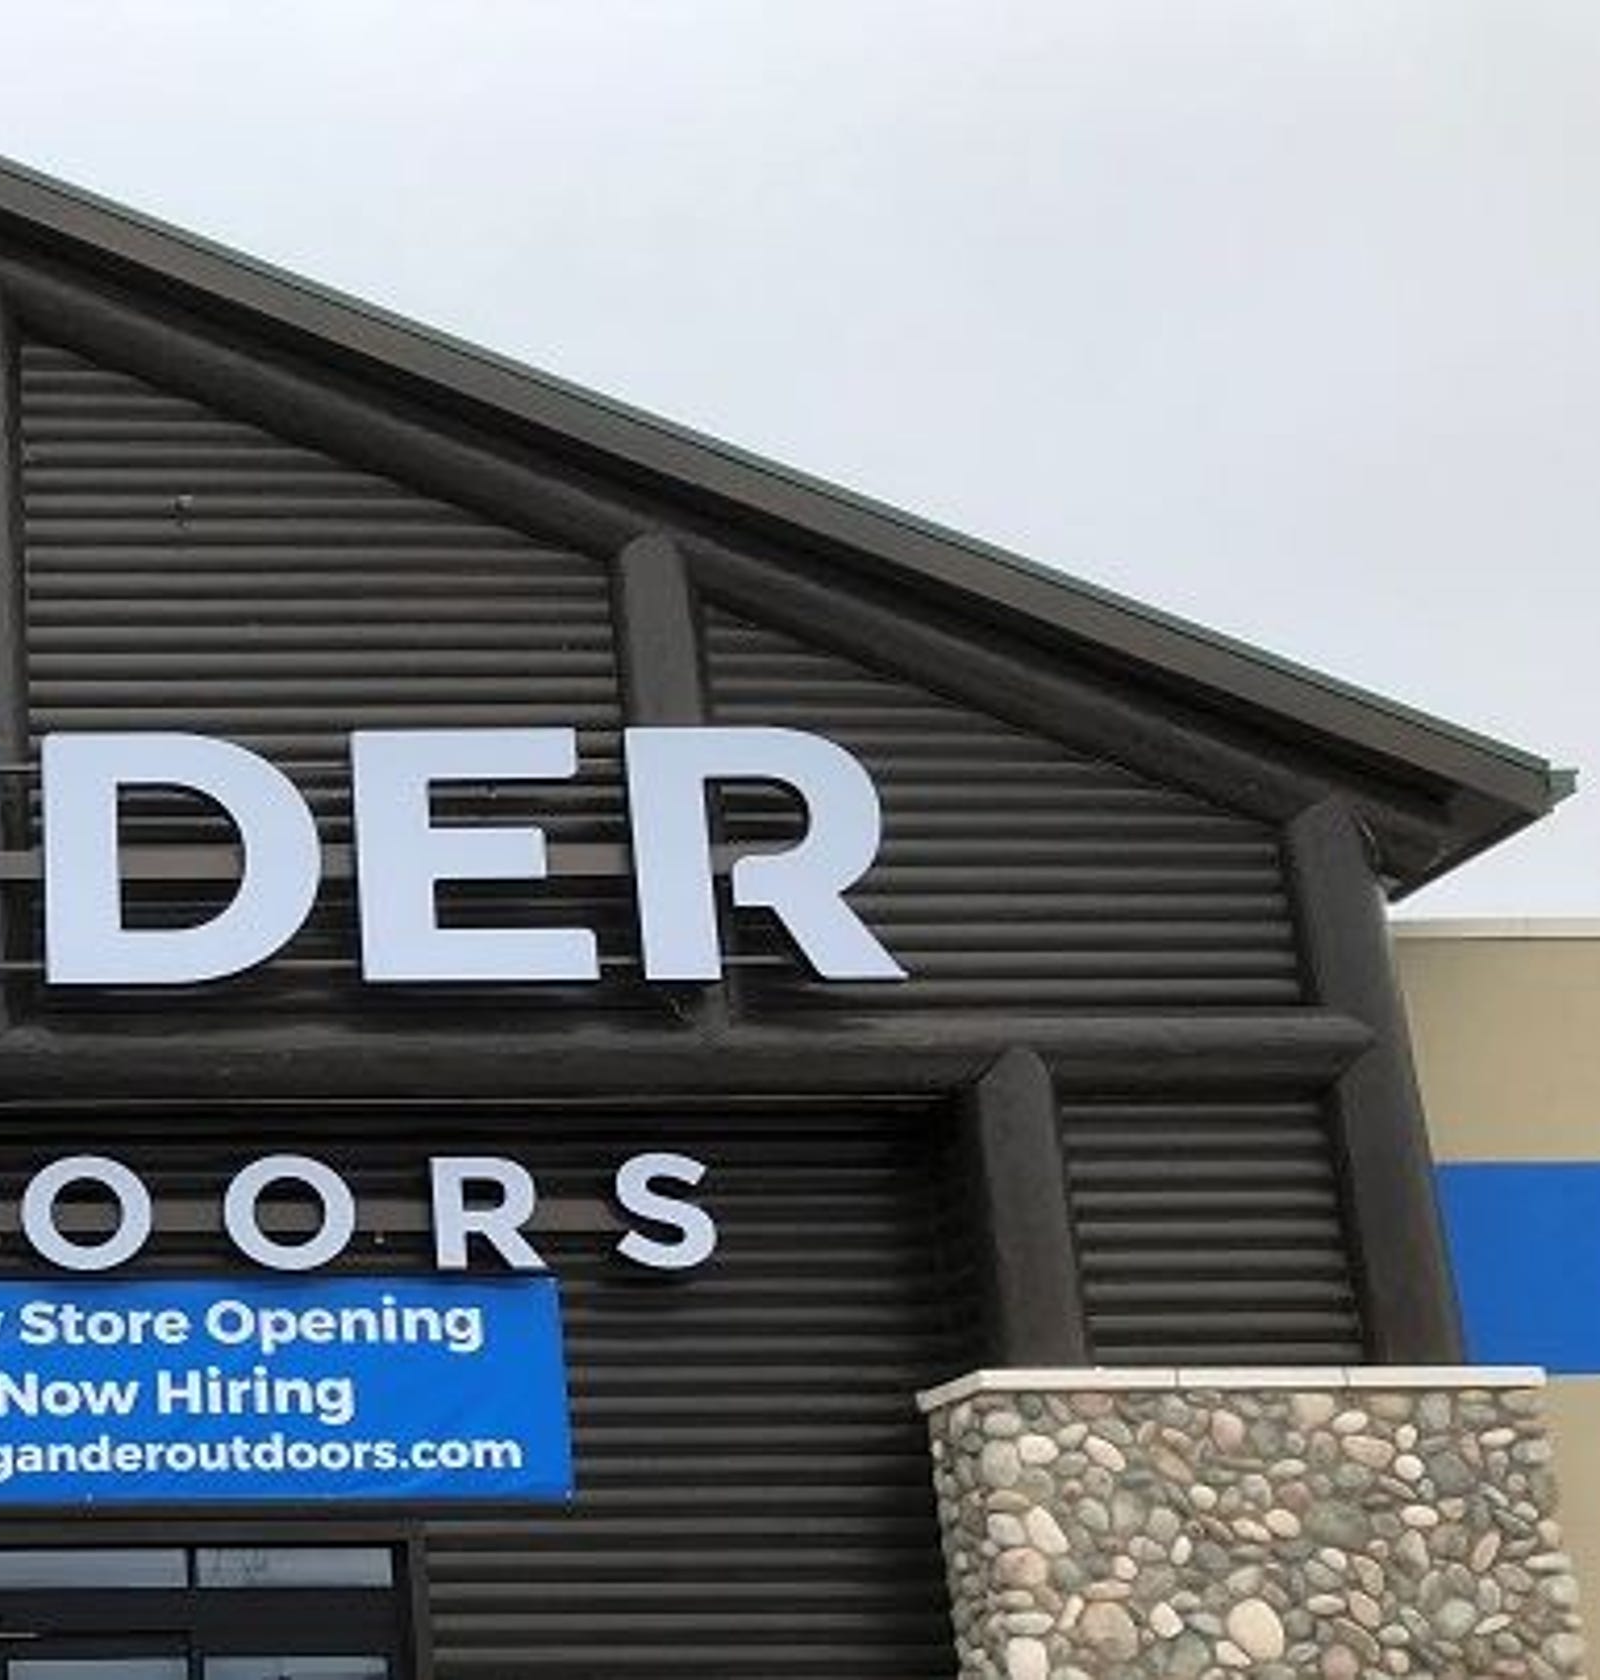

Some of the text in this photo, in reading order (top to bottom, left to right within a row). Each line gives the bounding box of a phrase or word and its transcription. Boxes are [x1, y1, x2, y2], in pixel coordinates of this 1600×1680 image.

[19, 1301, 191, 1346] Store
[205, 1295, 484, 1354] Opening
[157, 1366, 356, 1425] Hiring
